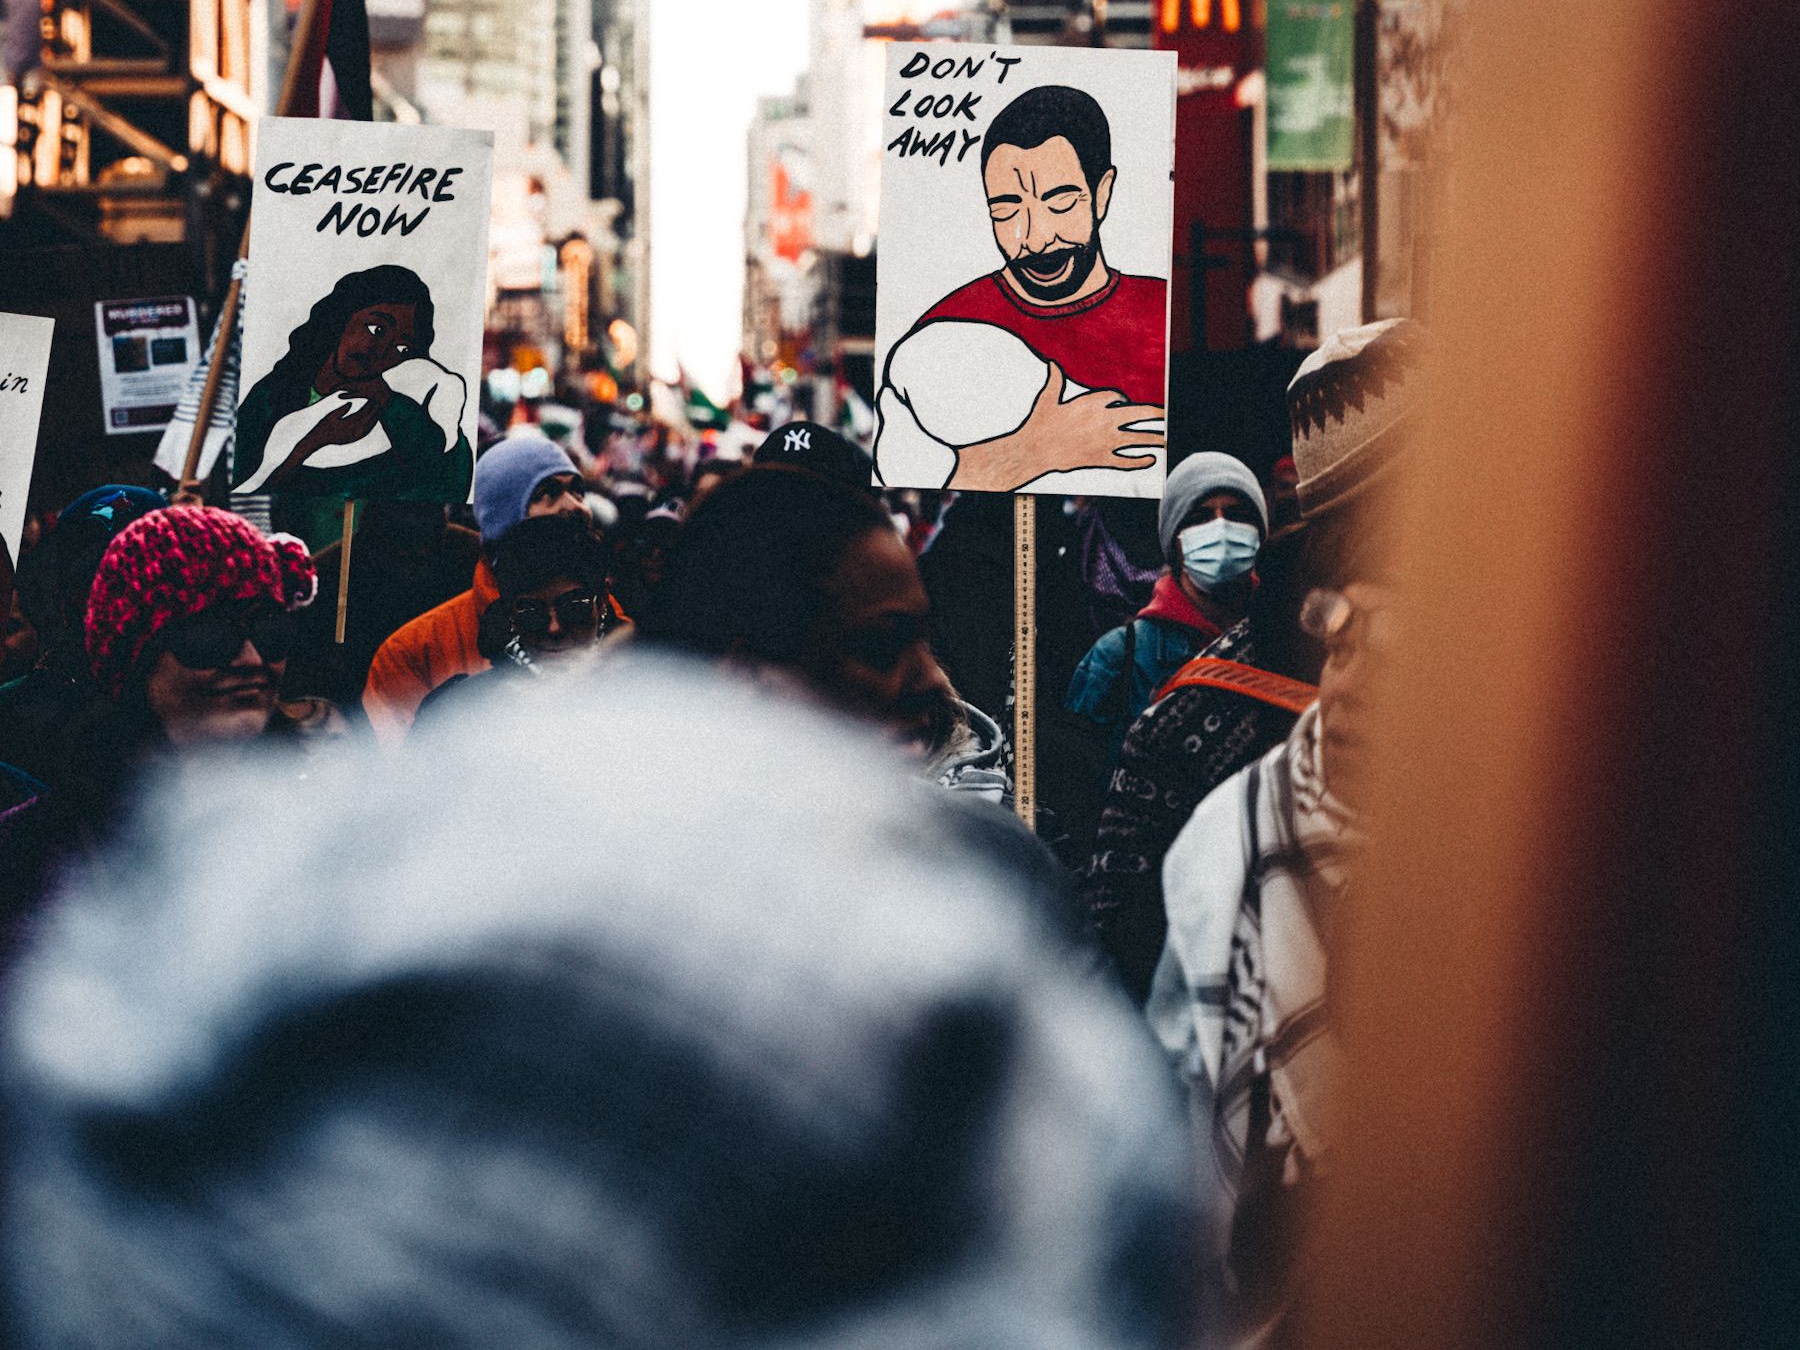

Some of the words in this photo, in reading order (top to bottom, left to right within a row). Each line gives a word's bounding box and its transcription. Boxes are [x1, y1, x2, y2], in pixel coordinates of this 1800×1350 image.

[899, 50, 1022, 84] DON'T
[889, 89, 983, 122] LOOK
[887, 125, 981, 168] AWAY
[264, 162, 464, 202] CEASEFIRE
[316, 201, 431, 238] NOW
[784, 428, 811, 451] NY
